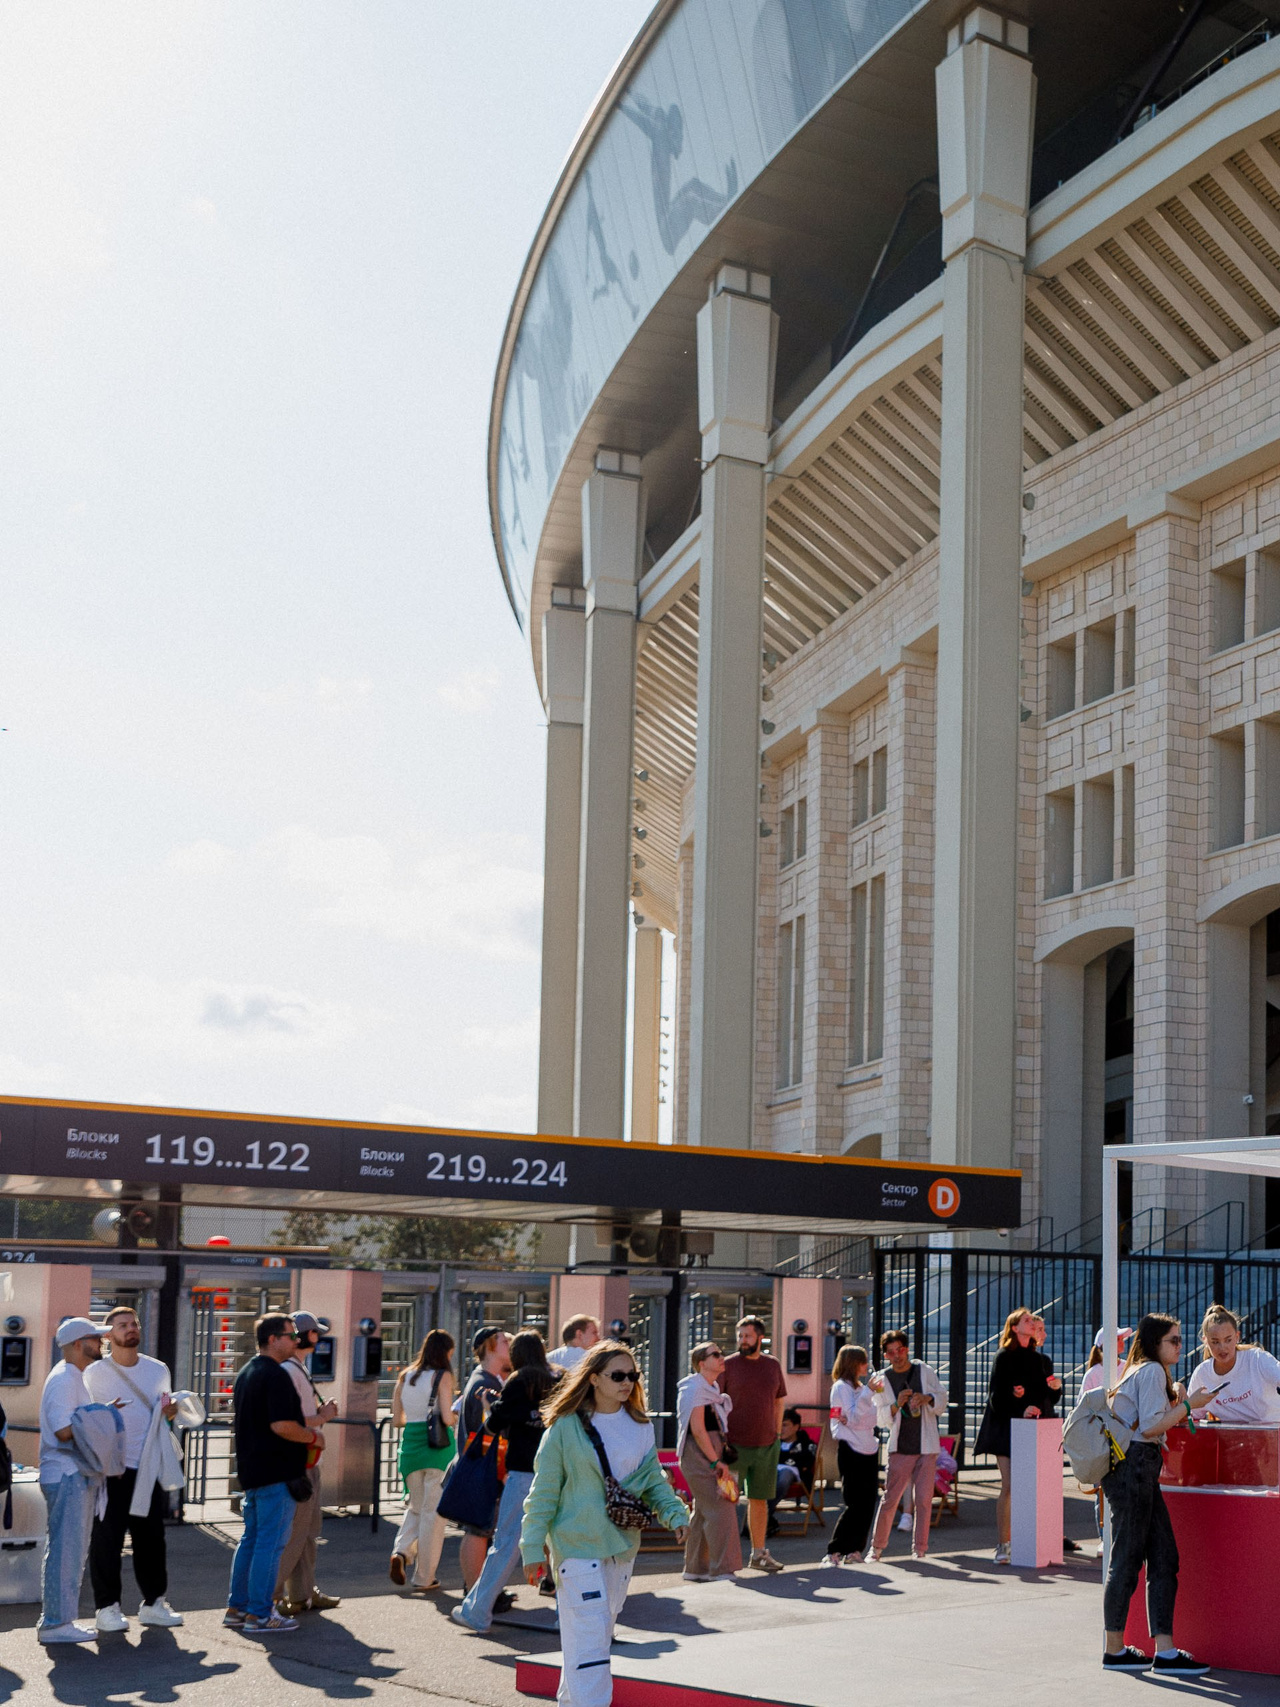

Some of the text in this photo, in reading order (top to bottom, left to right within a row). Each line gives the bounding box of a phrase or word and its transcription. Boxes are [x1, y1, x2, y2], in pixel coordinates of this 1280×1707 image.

[67, 1128, 120, 1144] Блоки
[66, 1147, 108, 1161] Blocks
[145, 1134, 311, 1172] 119...122
[360, 1148, 405, 1162] Блоки
[360, 1165, 395, 1178] Blocks
[427, 1152, 568, 1187] 219...224
[881, 1182, 919, 1196] Сектор
[881, 1197, 907, 1207] Sector
[936, 1186, 954, 1210] D
